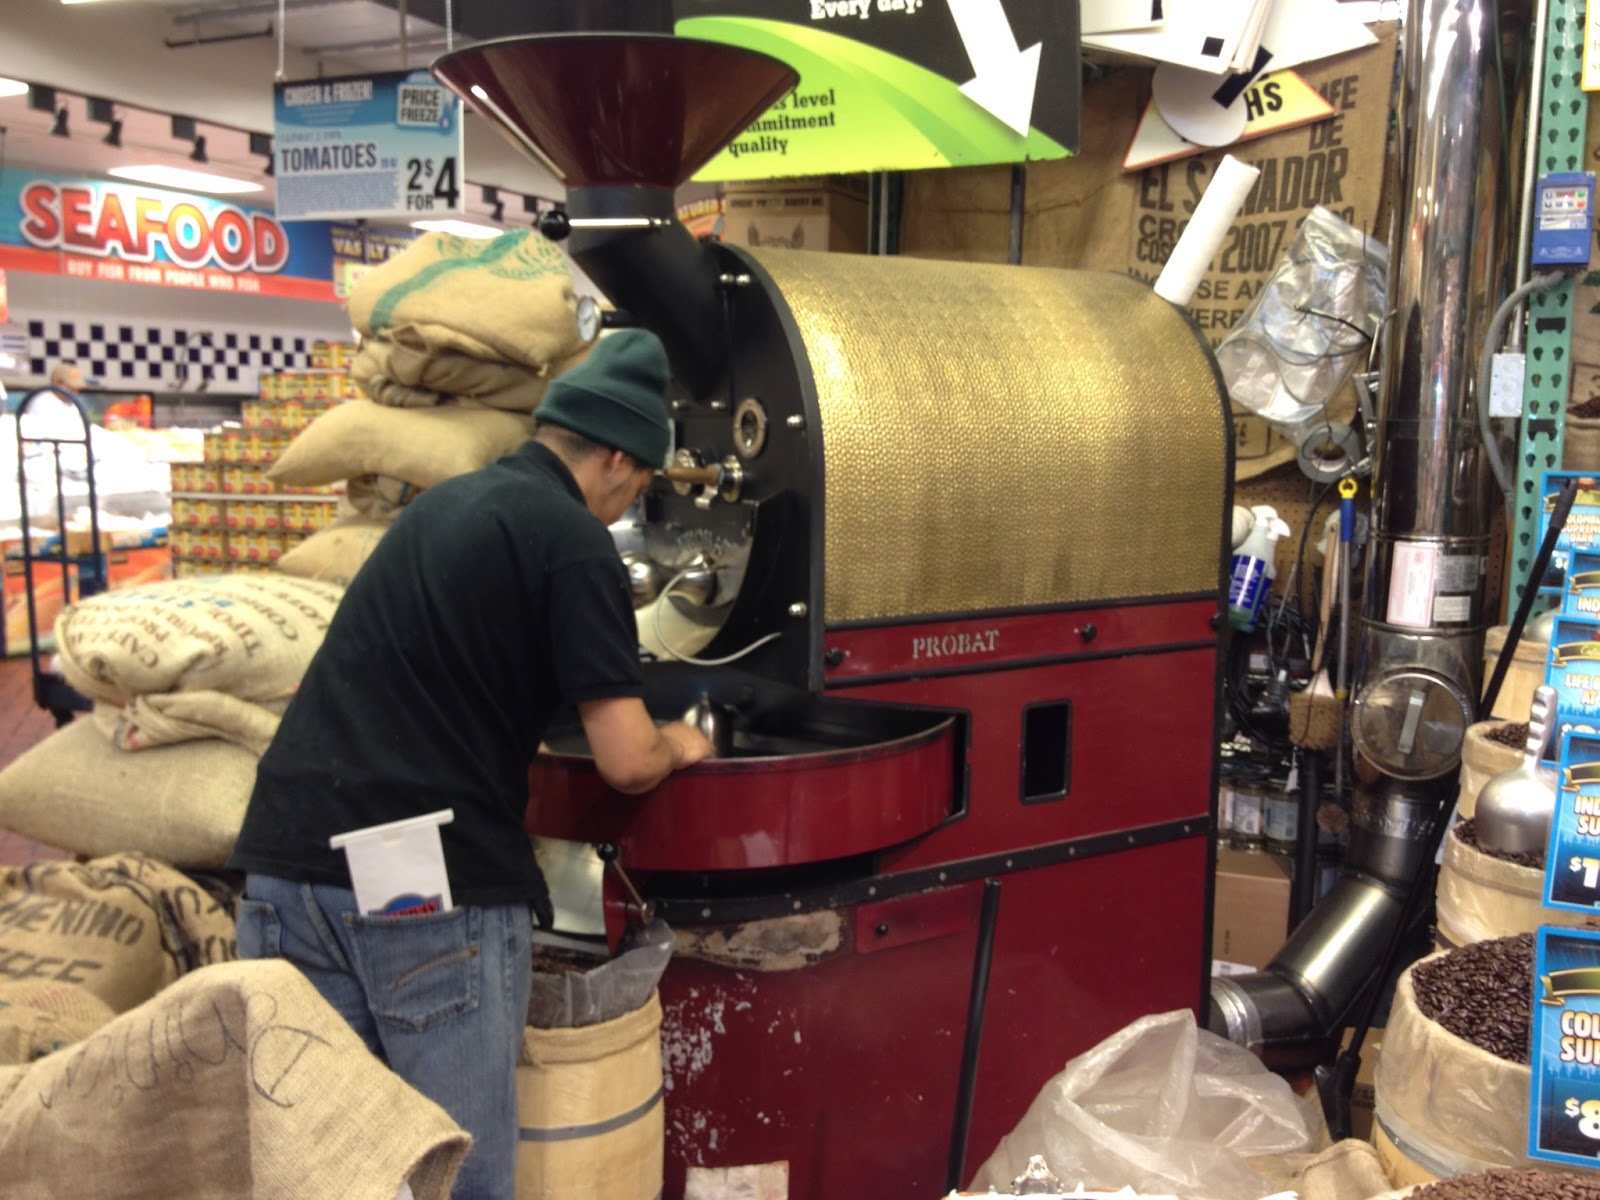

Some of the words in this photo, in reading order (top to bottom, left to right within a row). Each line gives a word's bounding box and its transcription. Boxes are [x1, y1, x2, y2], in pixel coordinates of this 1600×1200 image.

[809, 0, 871, 19] Every
[402, 89, 440, 106] PRICE
[793, 88, 835, 109] level
[1243, 81, 1283, 122] HS
[401, 107, 439, 123] FREEZE
[282, 143, 377, 172] TOMATOES
[728, 135, 788, 158] quality
[1140, 164, 1174, 212] EL
[407, 195, 434, 211] FOR
[22, 183, 288, 272] SEAFOOD
[912, 629, 999, 659] PROBAT
[1564, 673, 1591, 689] LIFE
[1577, 815, 1600, 836] SU
[1560, 1009, 1600, 1041] COL
[1559, 1034, 1600, 1066] SUP
